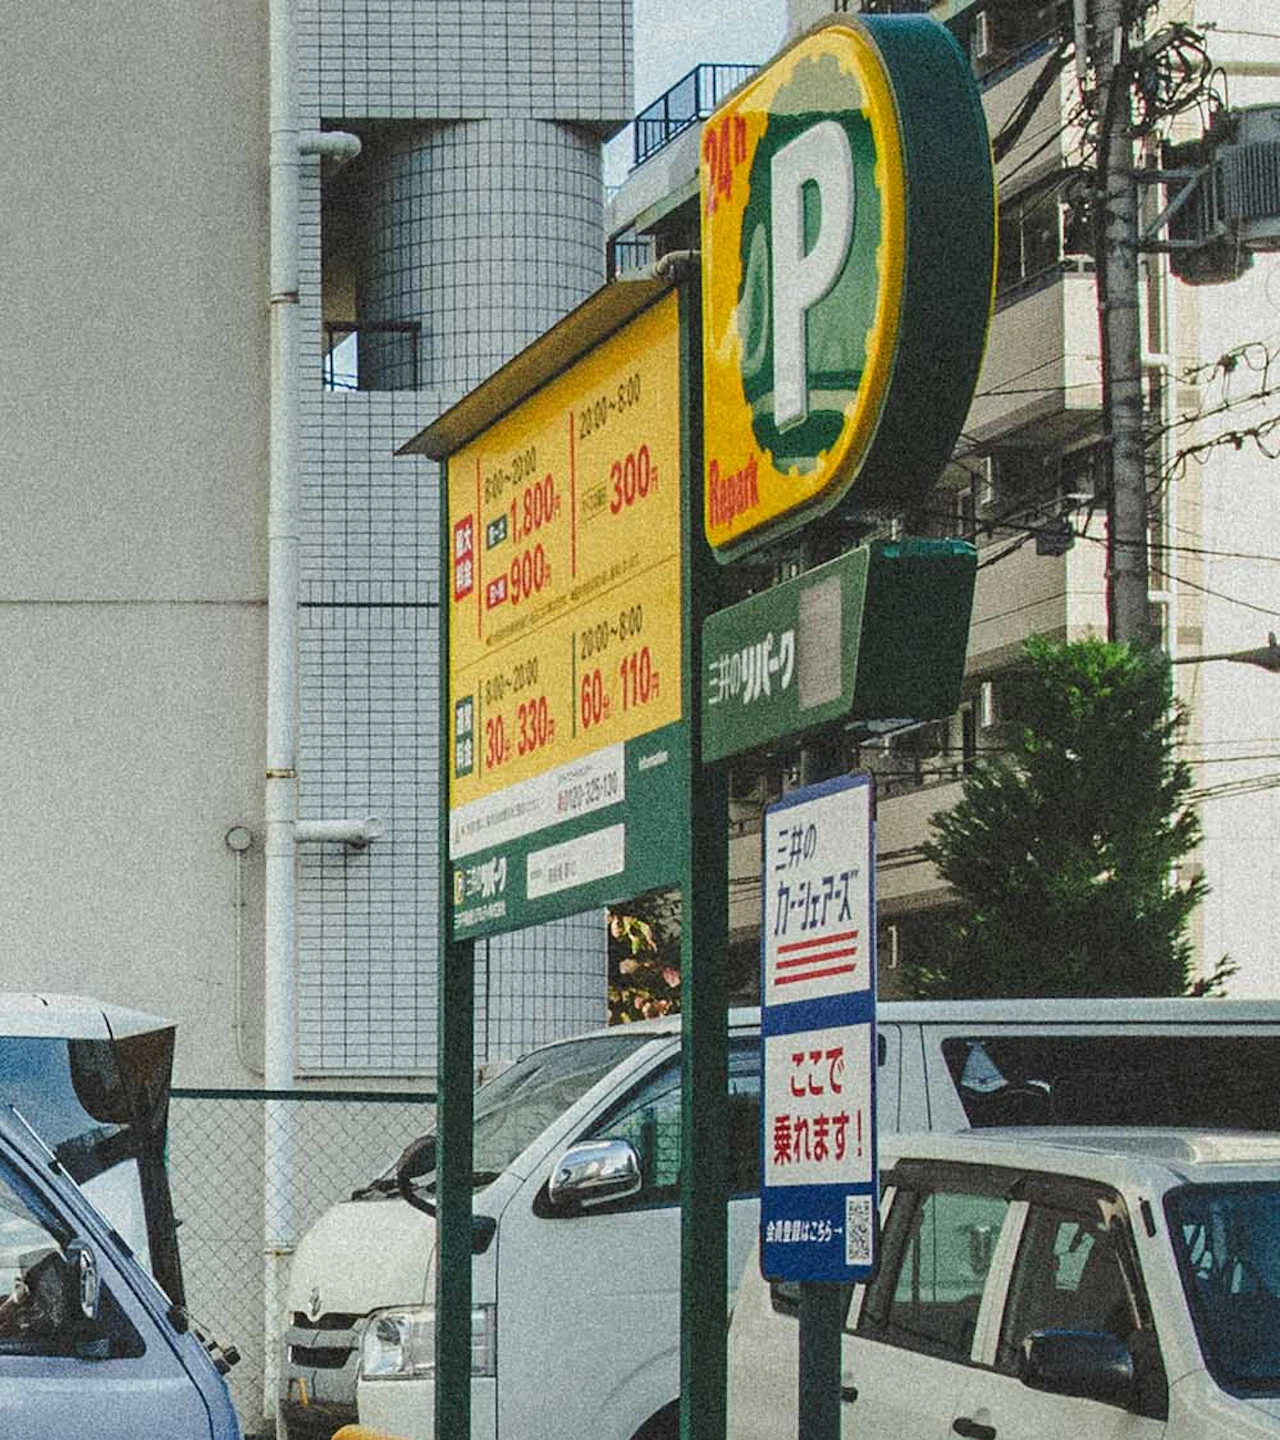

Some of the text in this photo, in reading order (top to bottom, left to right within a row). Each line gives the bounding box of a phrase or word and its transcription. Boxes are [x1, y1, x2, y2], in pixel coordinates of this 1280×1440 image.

[771, 119, 854, 435] P
[708, 629, 795, 705] 三井のリパーク
[775, 823, 817, 871] 三井の
[789, 1045, 845, 1097] ここで
